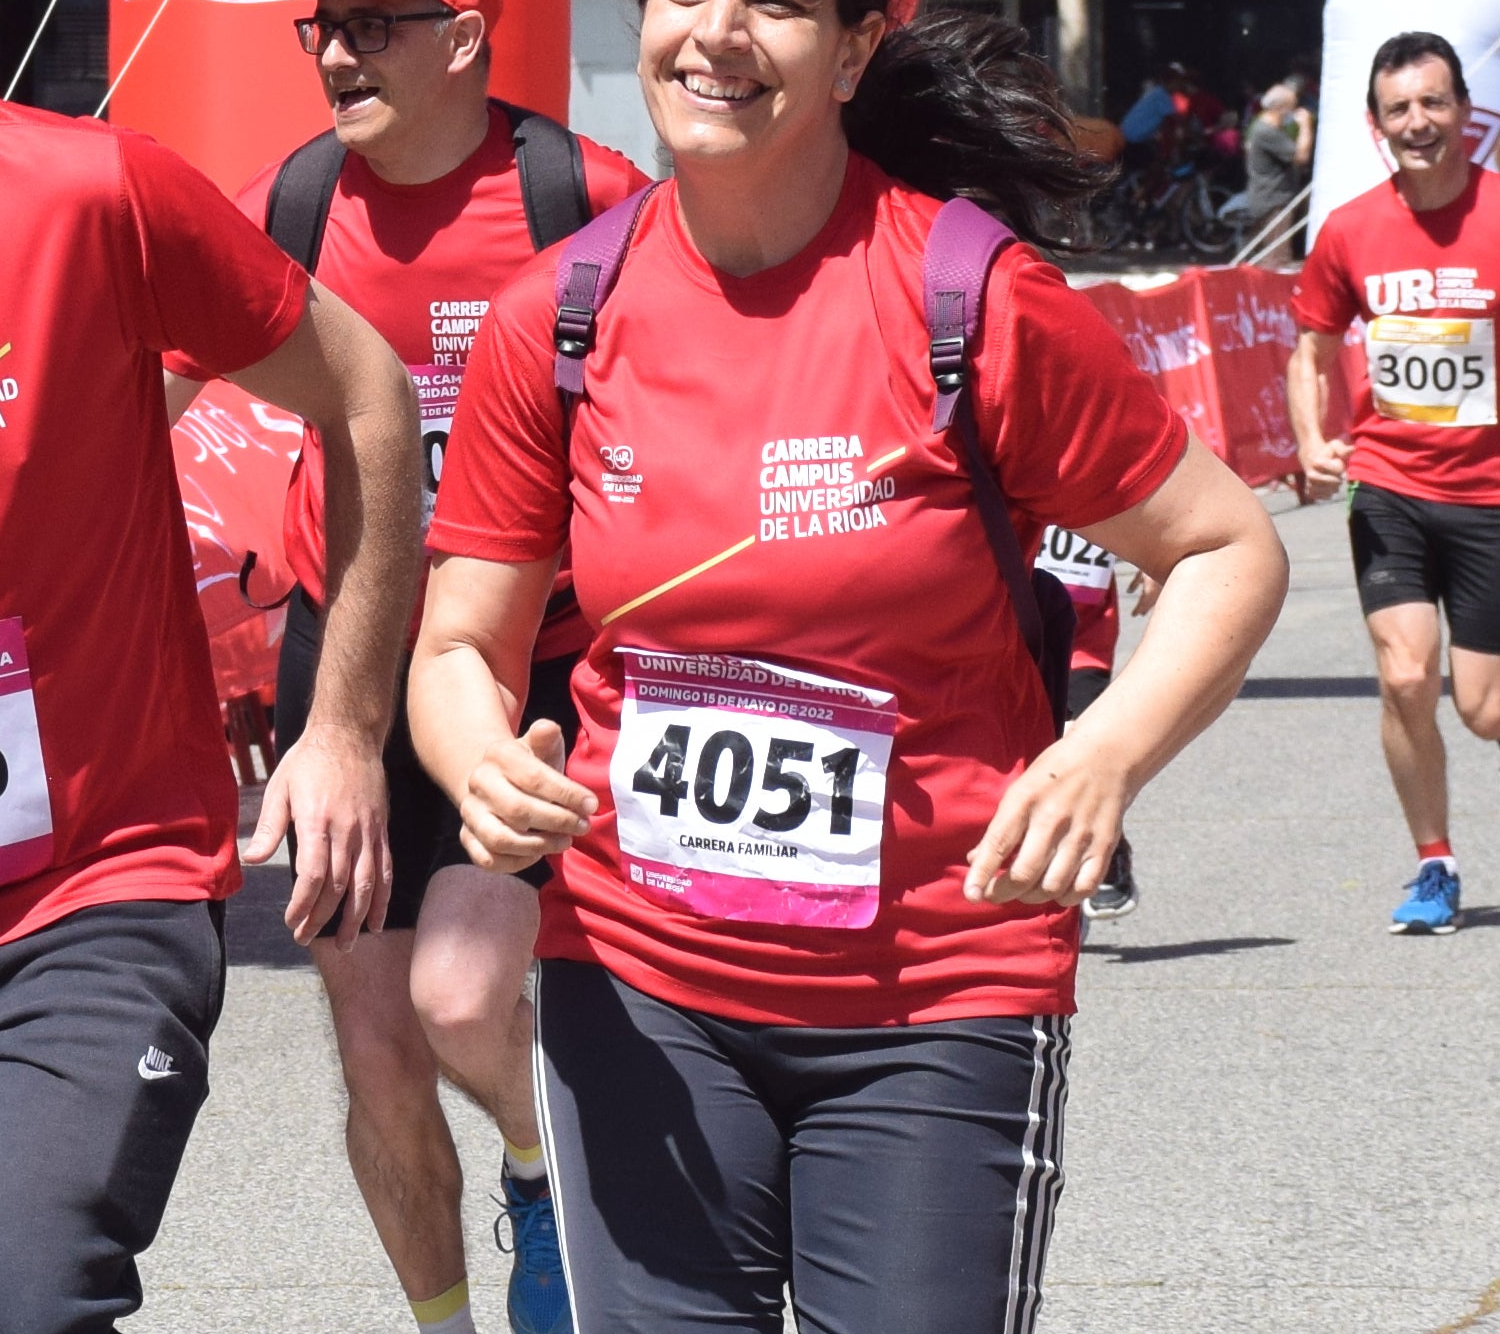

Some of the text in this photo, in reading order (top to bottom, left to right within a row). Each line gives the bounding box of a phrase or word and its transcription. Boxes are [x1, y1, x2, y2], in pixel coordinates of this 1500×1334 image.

[1365, 268, 1436, 315] UR
[1377, 354, 1484, 391] 3005
[761, 435, 863, 461] CARRERA
[760, 463, 854, 489] CAMPUS
[759, 476, 895, 516] UNIVERSIDAD
[760, 504, 887, 542] DE LA RIOJA
[638, 656, 767, 684] UNIVERSIDAD
[771, 673, 796, 688] DE
[638, 685, 834, 720] DOMINGO 15 DE MAYO DE 2022
[632, 723, 860, 836] 4051
[680, 834, 798, 858] CARRERA FAMILIAR
